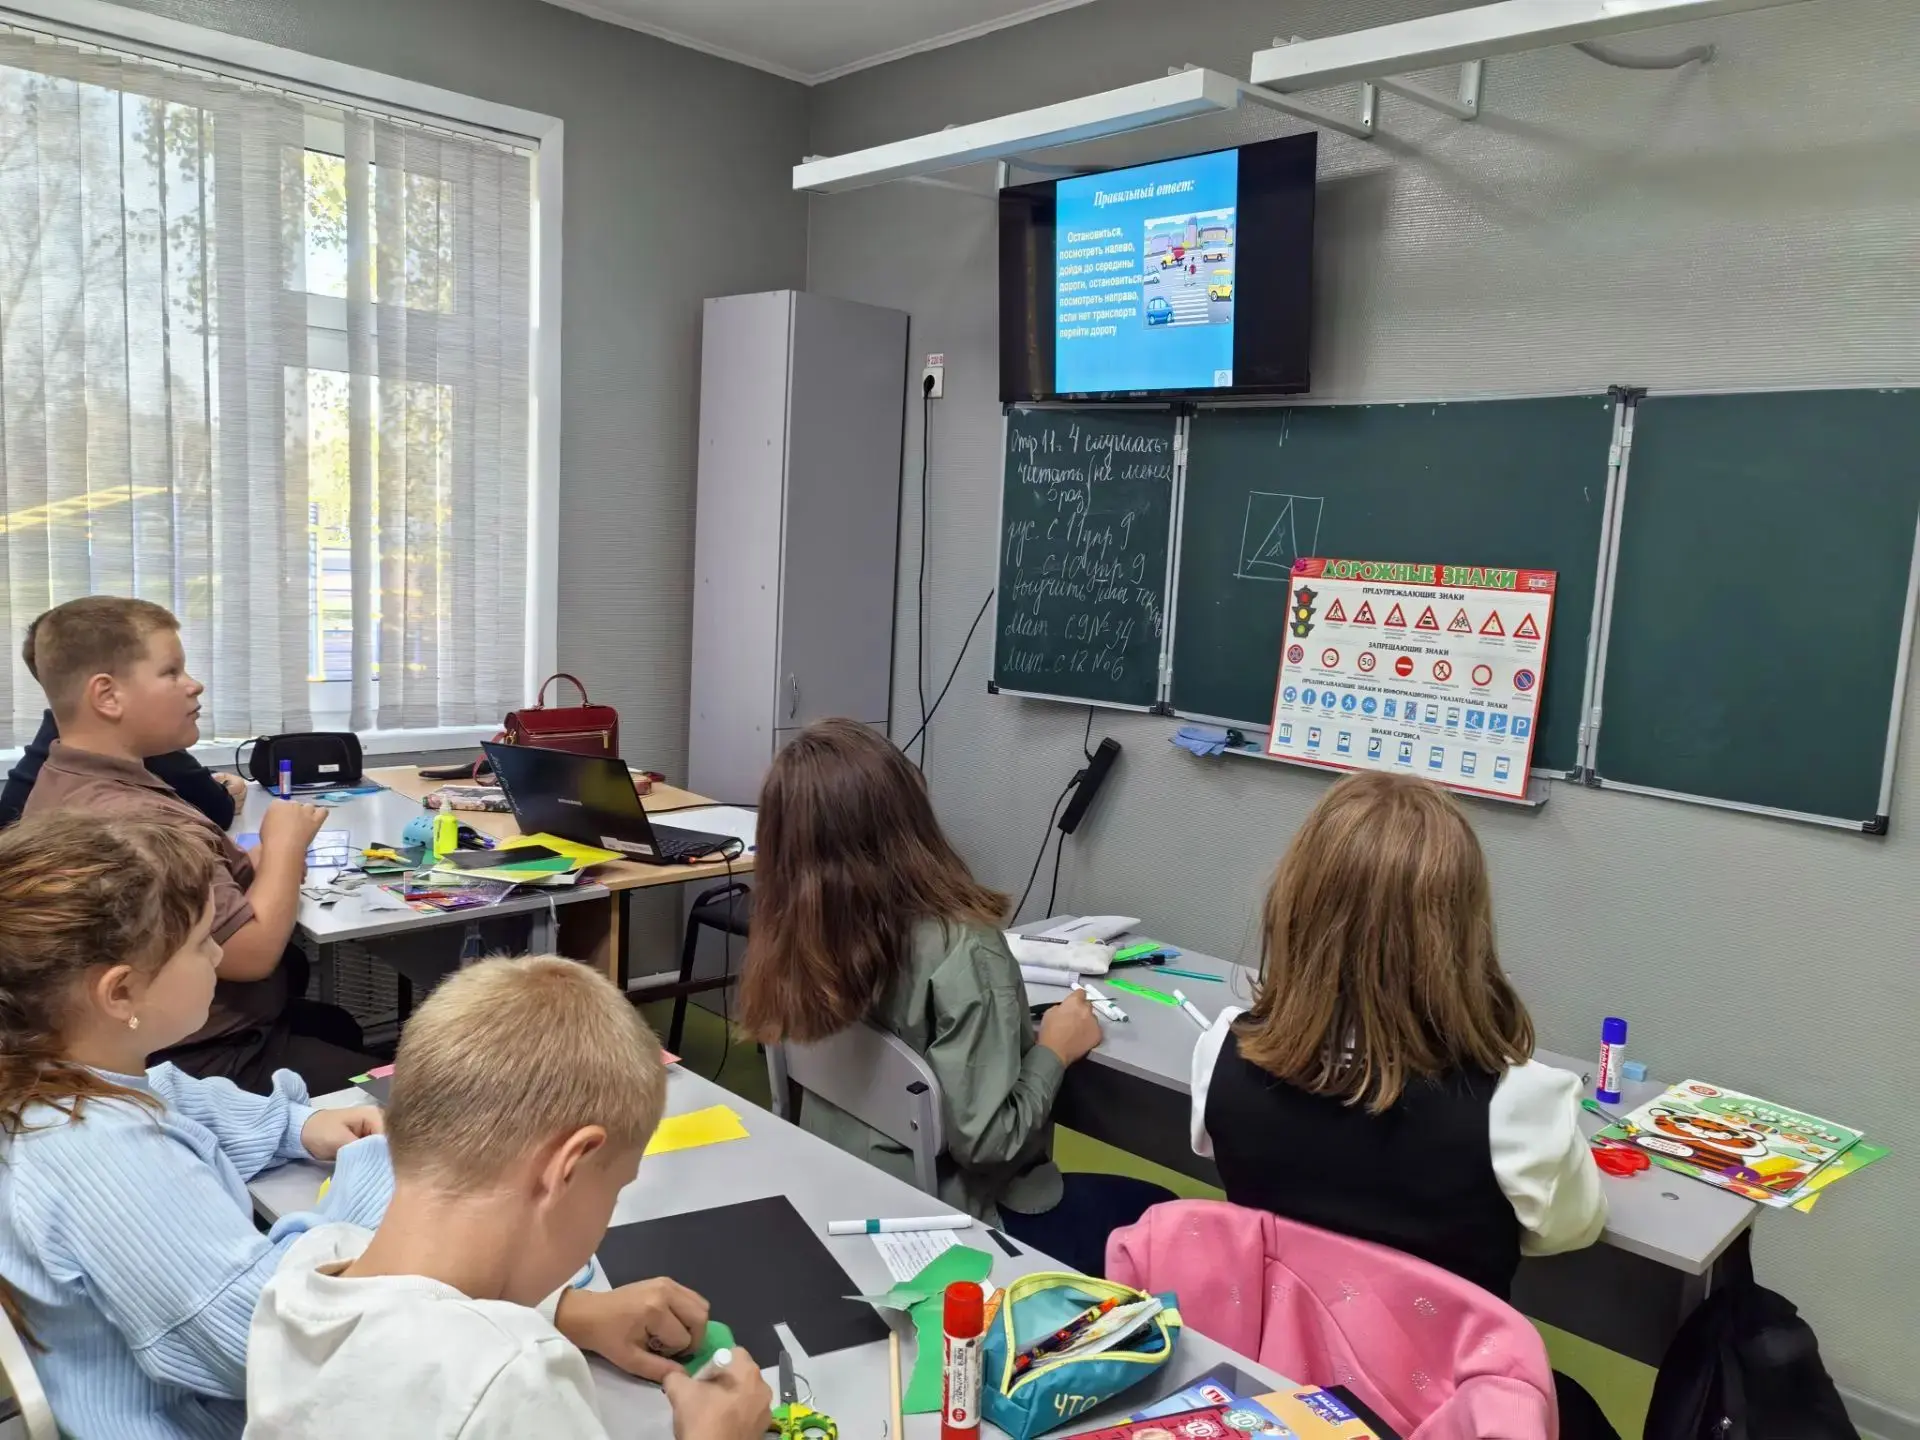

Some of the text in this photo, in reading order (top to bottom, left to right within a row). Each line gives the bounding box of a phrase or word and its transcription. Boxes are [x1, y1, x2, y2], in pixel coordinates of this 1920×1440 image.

[1094, 180, 1195, 208] Правильный ответ:
[1067, 227, 1123, 243] Остановиться,
[1059, 242, 1135, 260] посмотреть налево,
[1059, 259, 1134, 277] дойдя до середины
[1059, 281, 1088, 293] дороги,
[1059, 291, 1139, 307] посмотреть направо,
[1059, 307, 1137, 323] если нет транспорта
[1059, 325, 1117, 340] перейти дорогу
[1058, 489, 1085, 514] раз
[1320, 559, 1436, 585] ДОРОЖНЫЕ
[1441, 566, 1519, 590] ЗНАКИ
[1362, 587, 1465, 601] ПРЕДУПРЕЖДАЮЩИЕ ЗНАКИ
[1368, 641, 1450, 656] ЗАПРЕЩАЮЩИЕ ЗНАКИ
[1361, 657, 1372, 667] 50
[1301, 678, 1356, 690] ПРЕДПИСЫВАЮЩИЕ
[1357, 684, 1377, 693] ЗНАКИ
[1486, 702, 1508, 710] ЗНАКИ
[1371, 727, 1421, 741] ЗНАКИ СЕРВИСА
